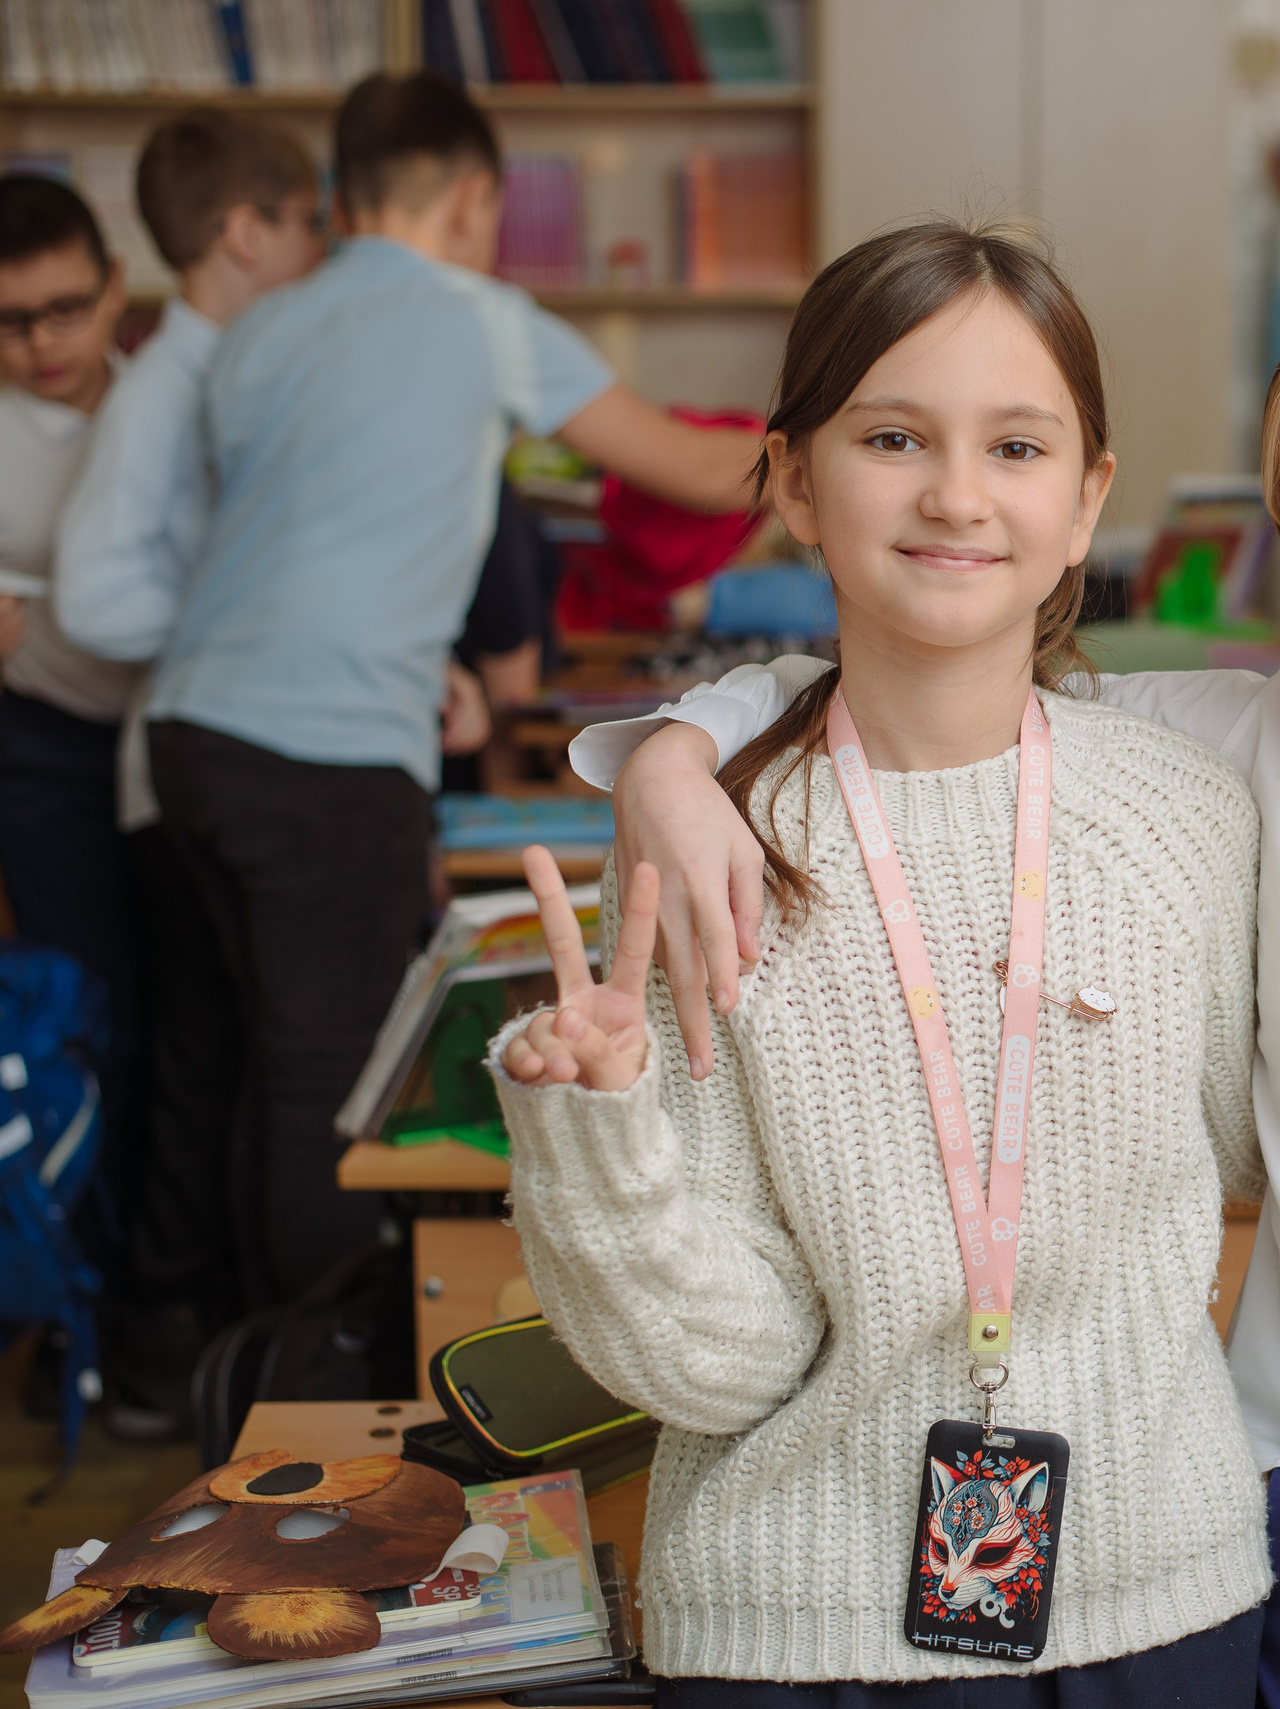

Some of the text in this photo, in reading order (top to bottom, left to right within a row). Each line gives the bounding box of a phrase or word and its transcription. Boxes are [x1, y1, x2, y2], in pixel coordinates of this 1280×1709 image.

[844, 755, 882, 845] CUTE BEAR
[1026, 745, 1045, 839] CUTE BEAR
[929, 1050, 963, 1150] CUTE BEAR
[1001, 1050, 1026, 1149] CUTE BEAR
[954, 1163, 987, 1266] CUTE BEAR
[976, 1283, 997, 1312] AR
[912, 1632, 1034, 1658] HITSUNE
